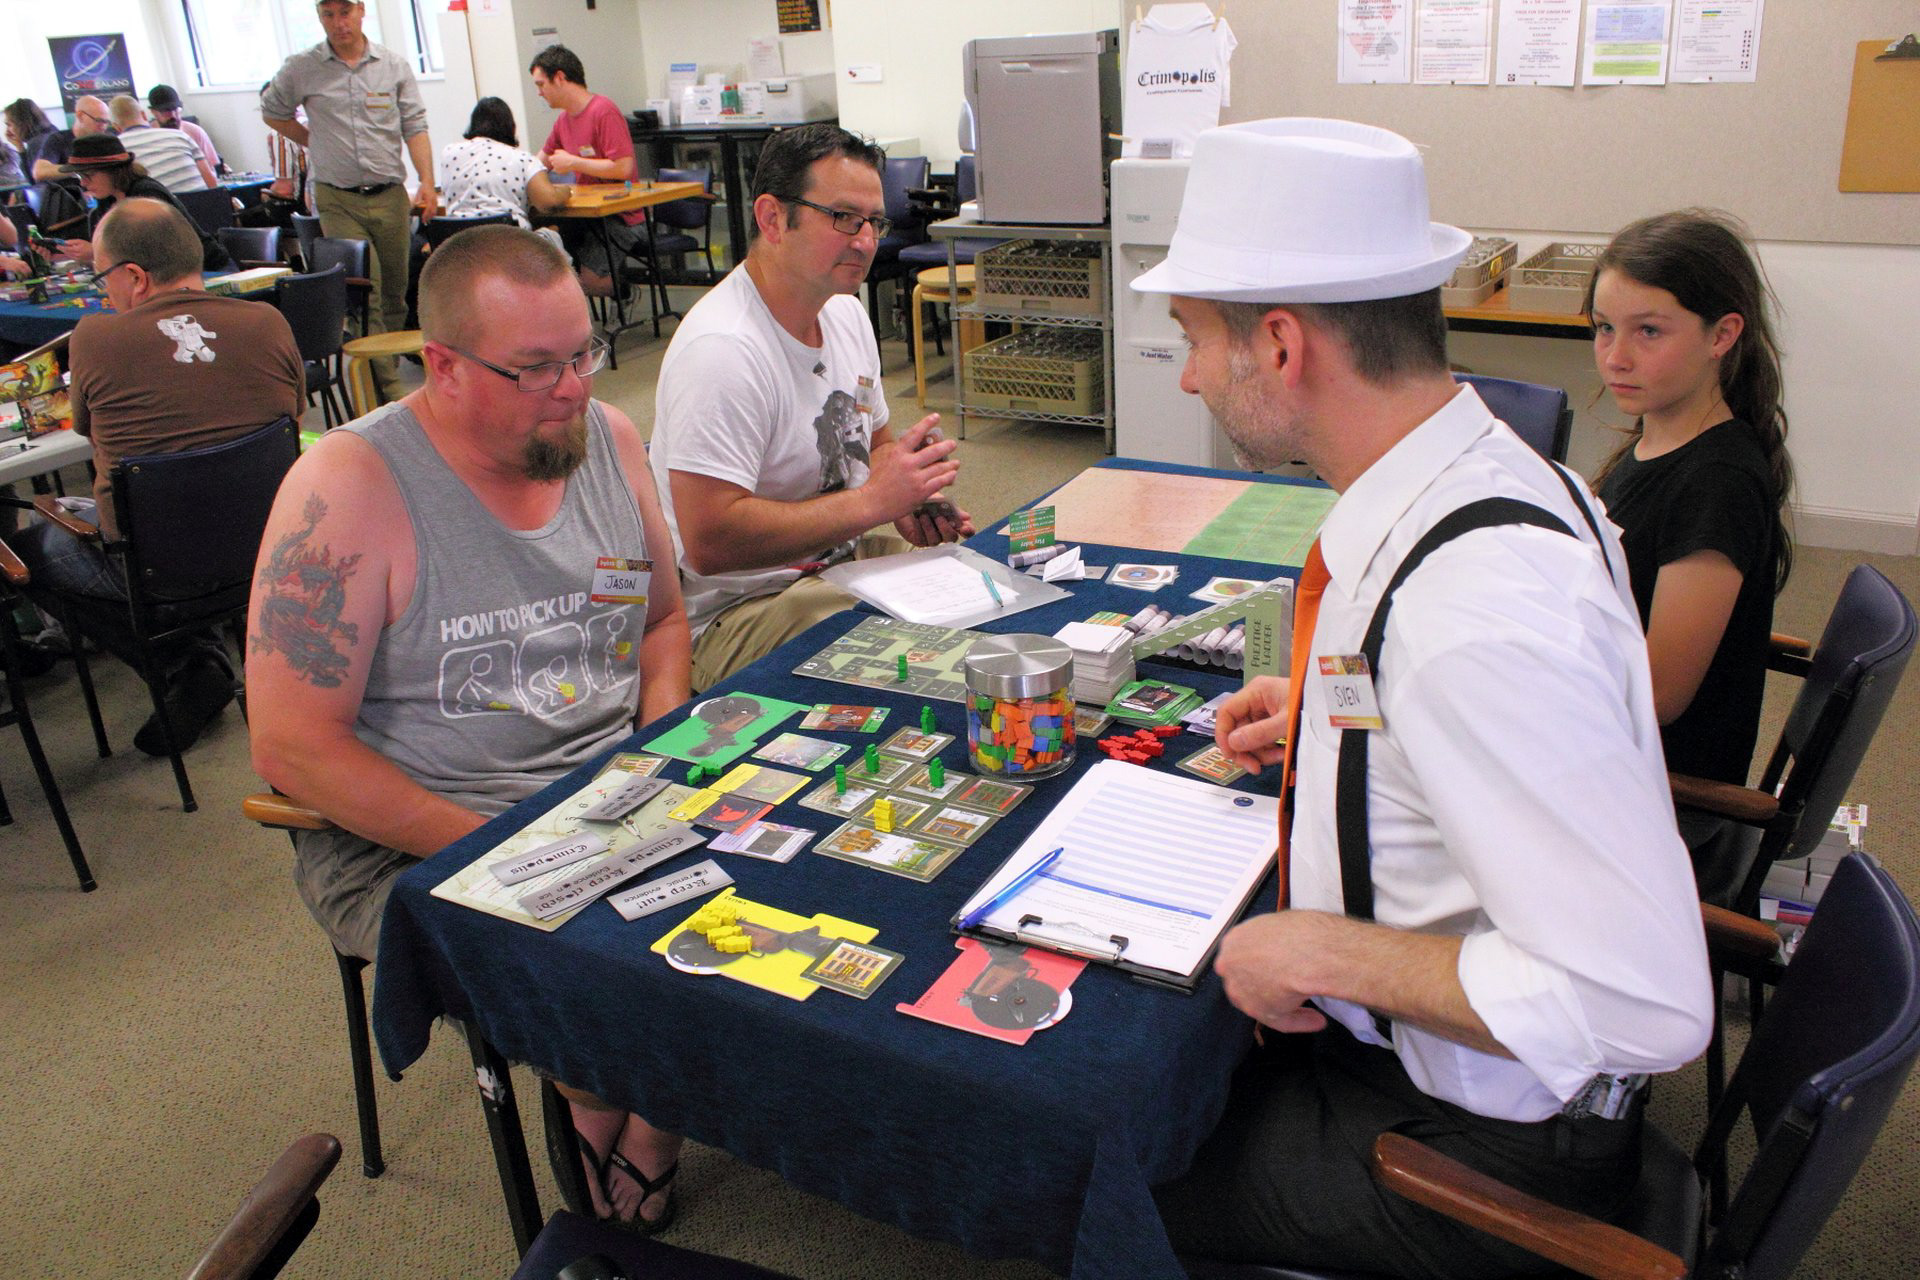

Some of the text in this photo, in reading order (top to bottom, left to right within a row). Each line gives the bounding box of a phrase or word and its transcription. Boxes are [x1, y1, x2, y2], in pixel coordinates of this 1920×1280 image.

[1137, 68, 1217, 87] Crimopolis
[604, 575, 637, 591] JASON
[440, 591, 587, 643] HOW TO PICK UP
[1250, 618, 1262, 668] PRESTIGE
[1261, 623, 1273, 667] LADDER
[1334, 684, 1360, 708] SVEN
[510, 844, 588, 875] Crimopolis
[573, 865, 611, 886] Evidence
[535, 867, 628, 912] Keep closed!
[538, 891, 552, 901] ice
[623, 869, 708, 904] Forensic evidence
[635, 877, 711, 910] Keep out!
